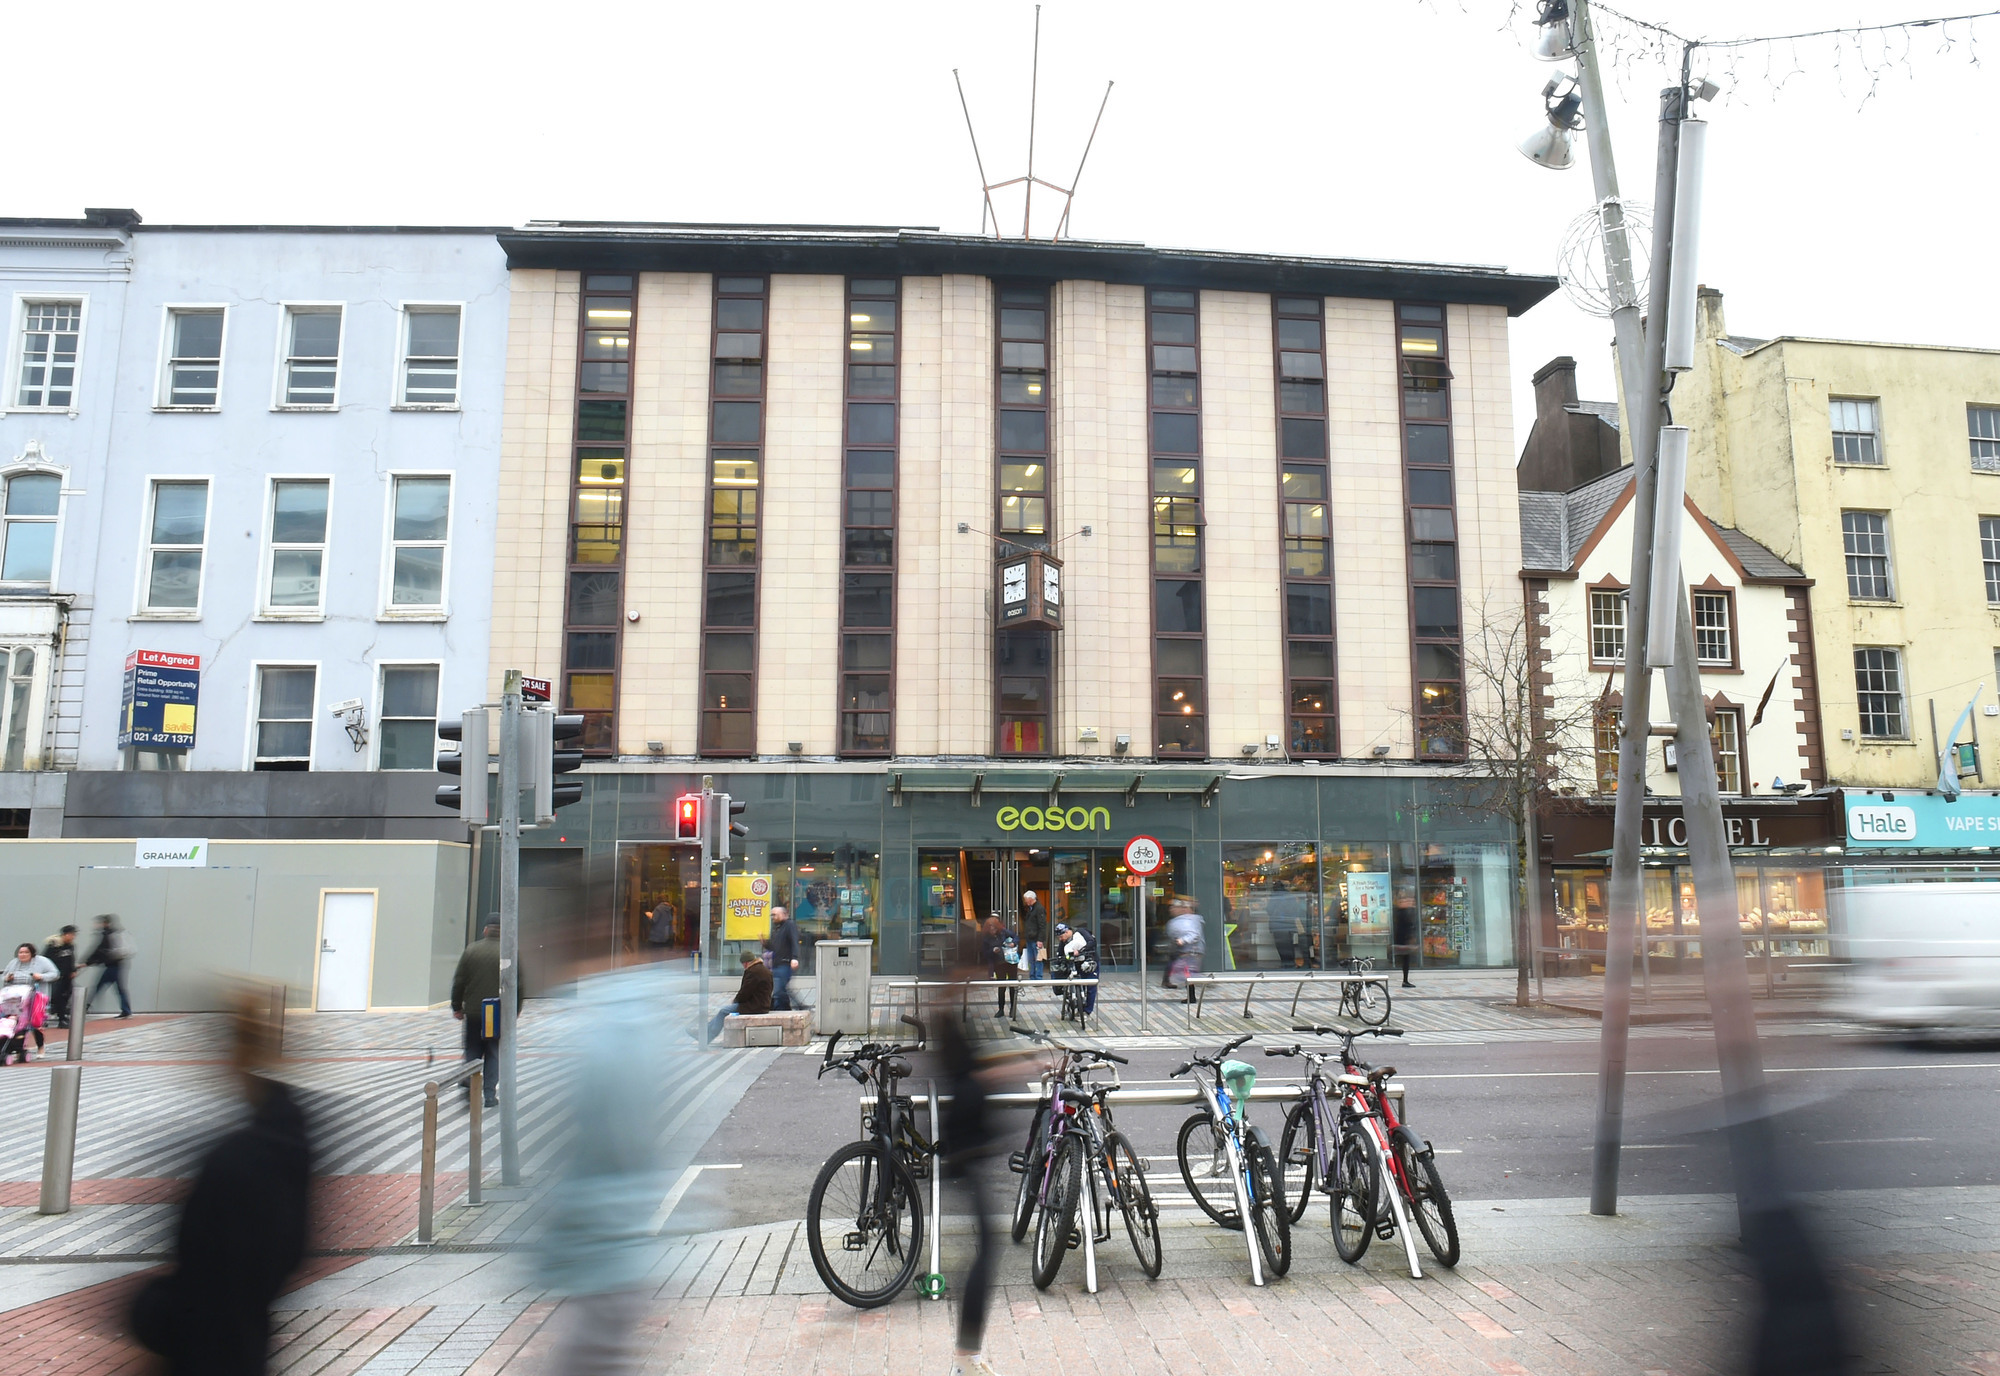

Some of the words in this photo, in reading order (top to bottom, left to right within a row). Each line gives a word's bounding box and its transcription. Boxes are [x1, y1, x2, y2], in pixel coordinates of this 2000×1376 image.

[143, 652, 159, 662] Let
[160, 654, 194, 665] Agreed
[138, 669, 158, 677] Prime
[137, 677, 157, 685] Retail
[157, 679, 197, 690] Opportunity
[521, 679, 530, 689] OR
[531, 680, 546, 691] SALE
[165, 723, 192, 732] savills
[134, 732, 149, 741] 021
[152, 733, 169, 743] 427
[172, 734, 194, 744] 1371
[996, 806, 1110, 831] eason
[1858, 813, 1907, 833] Hale
[1945, 816, 1984, 831] VAPE
[1988, 816, 2000, 831] S
[142, 852, 188, 860] GRAHAM
[728, 899, 768, 909] JANUARY
[735, 905, 762, 917] SALE
